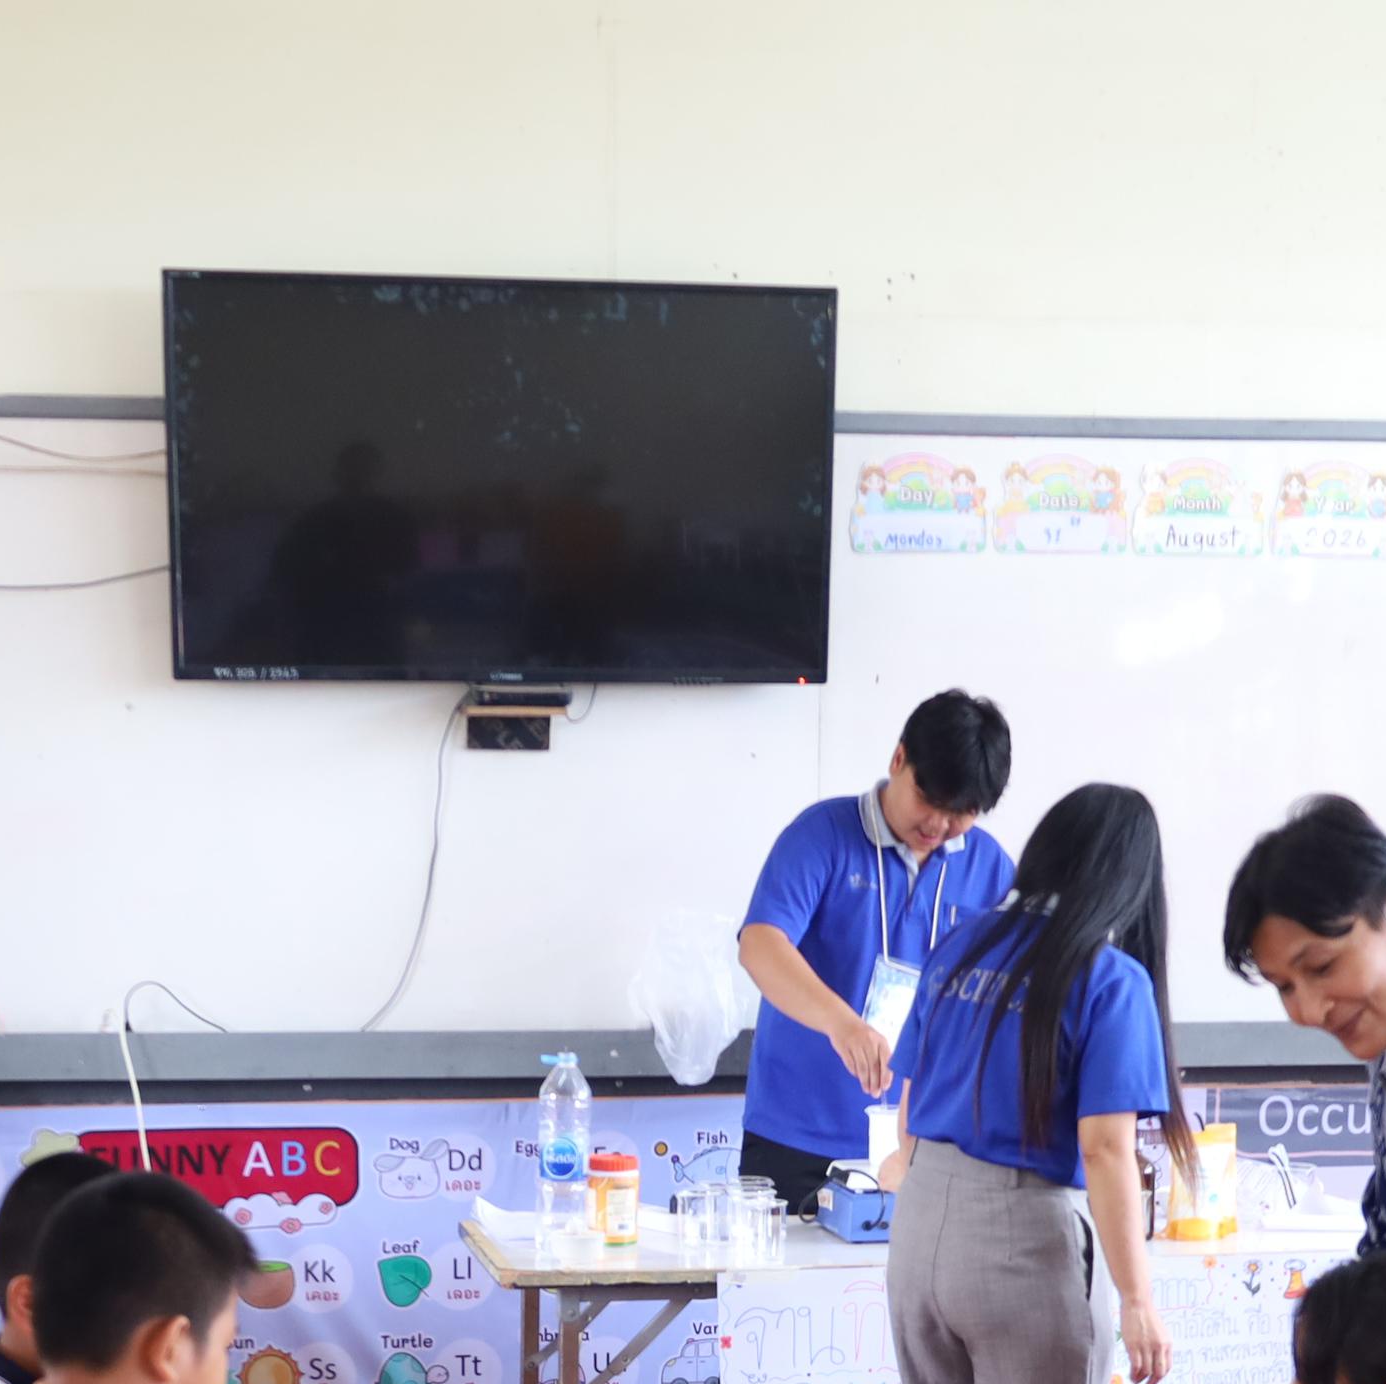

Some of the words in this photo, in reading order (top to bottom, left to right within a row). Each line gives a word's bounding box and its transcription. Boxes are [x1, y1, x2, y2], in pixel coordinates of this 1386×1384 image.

[899, 485, 935, 506] Day
[1038, 493, 1079, 508] Date
[1173, 495, 1220, 510] Month
[1165, 523, 1241, 553] August
[389, 1137, 420, 1154] Dog
[696, 1131, 728, 1145] Fish
[448, 1147, 483, 1172] Dd
[382, 1240, 420, 1254] Leaf
[304, 1258, 335, 1283] Kk
[227, 1337, 255, 1349] un
[381, 1333, 434, 1349] Turtle
[309, 1357, 337, 1380] Ss
[455, 1354, 482, 1377] Tt
